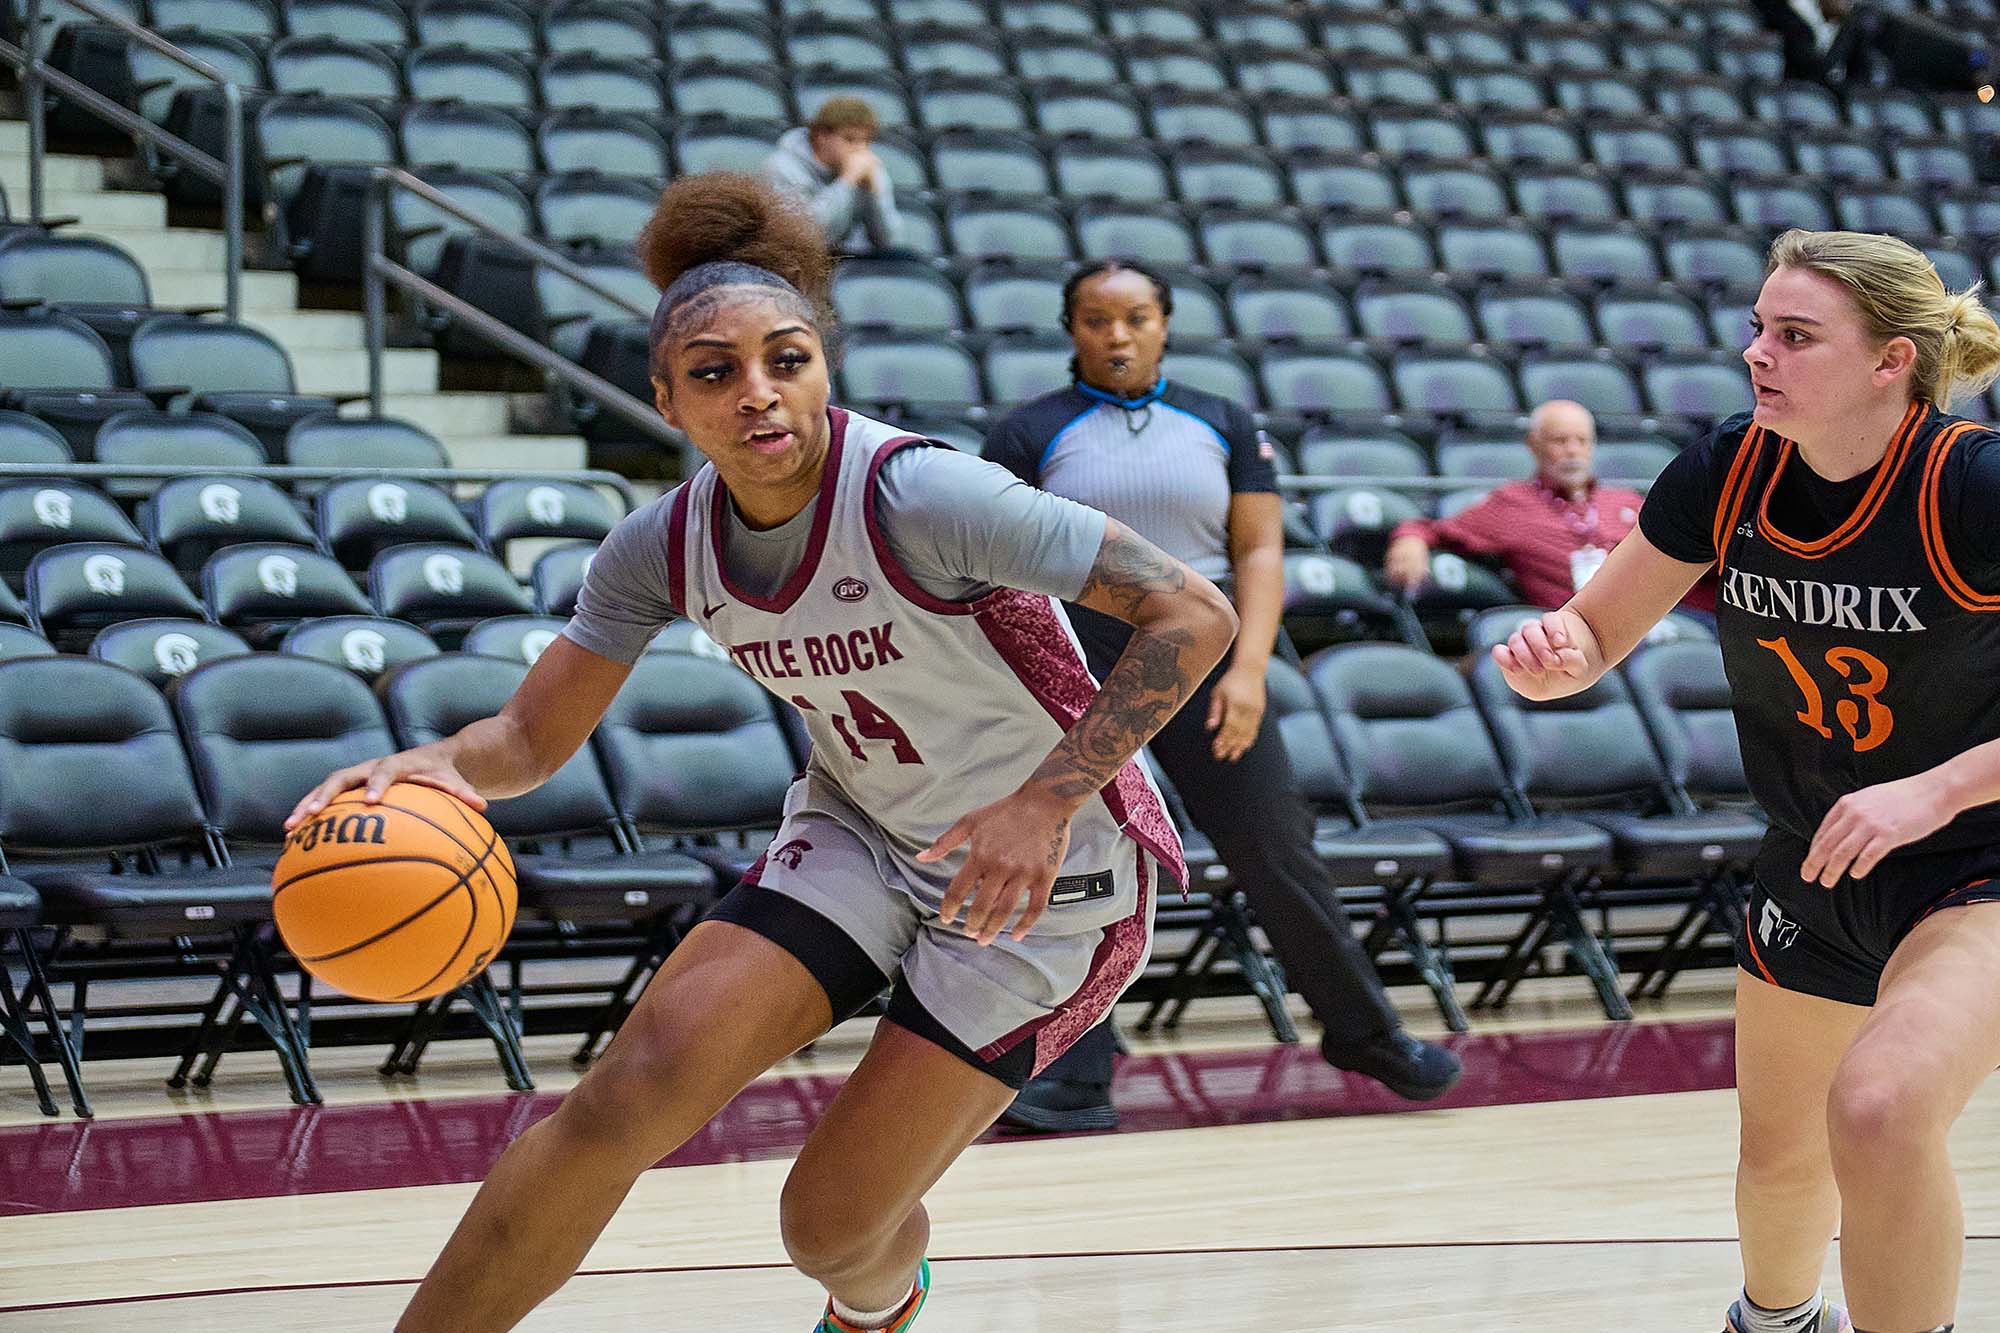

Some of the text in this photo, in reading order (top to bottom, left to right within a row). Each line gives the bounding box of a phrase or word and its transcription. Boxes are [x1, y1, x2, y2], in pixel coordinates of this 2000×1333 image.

[731, 621, 904, 678] TTLE ROCK
[1756, 636, 1894, 752] 13
[1096, 881, 1103, 891] L
